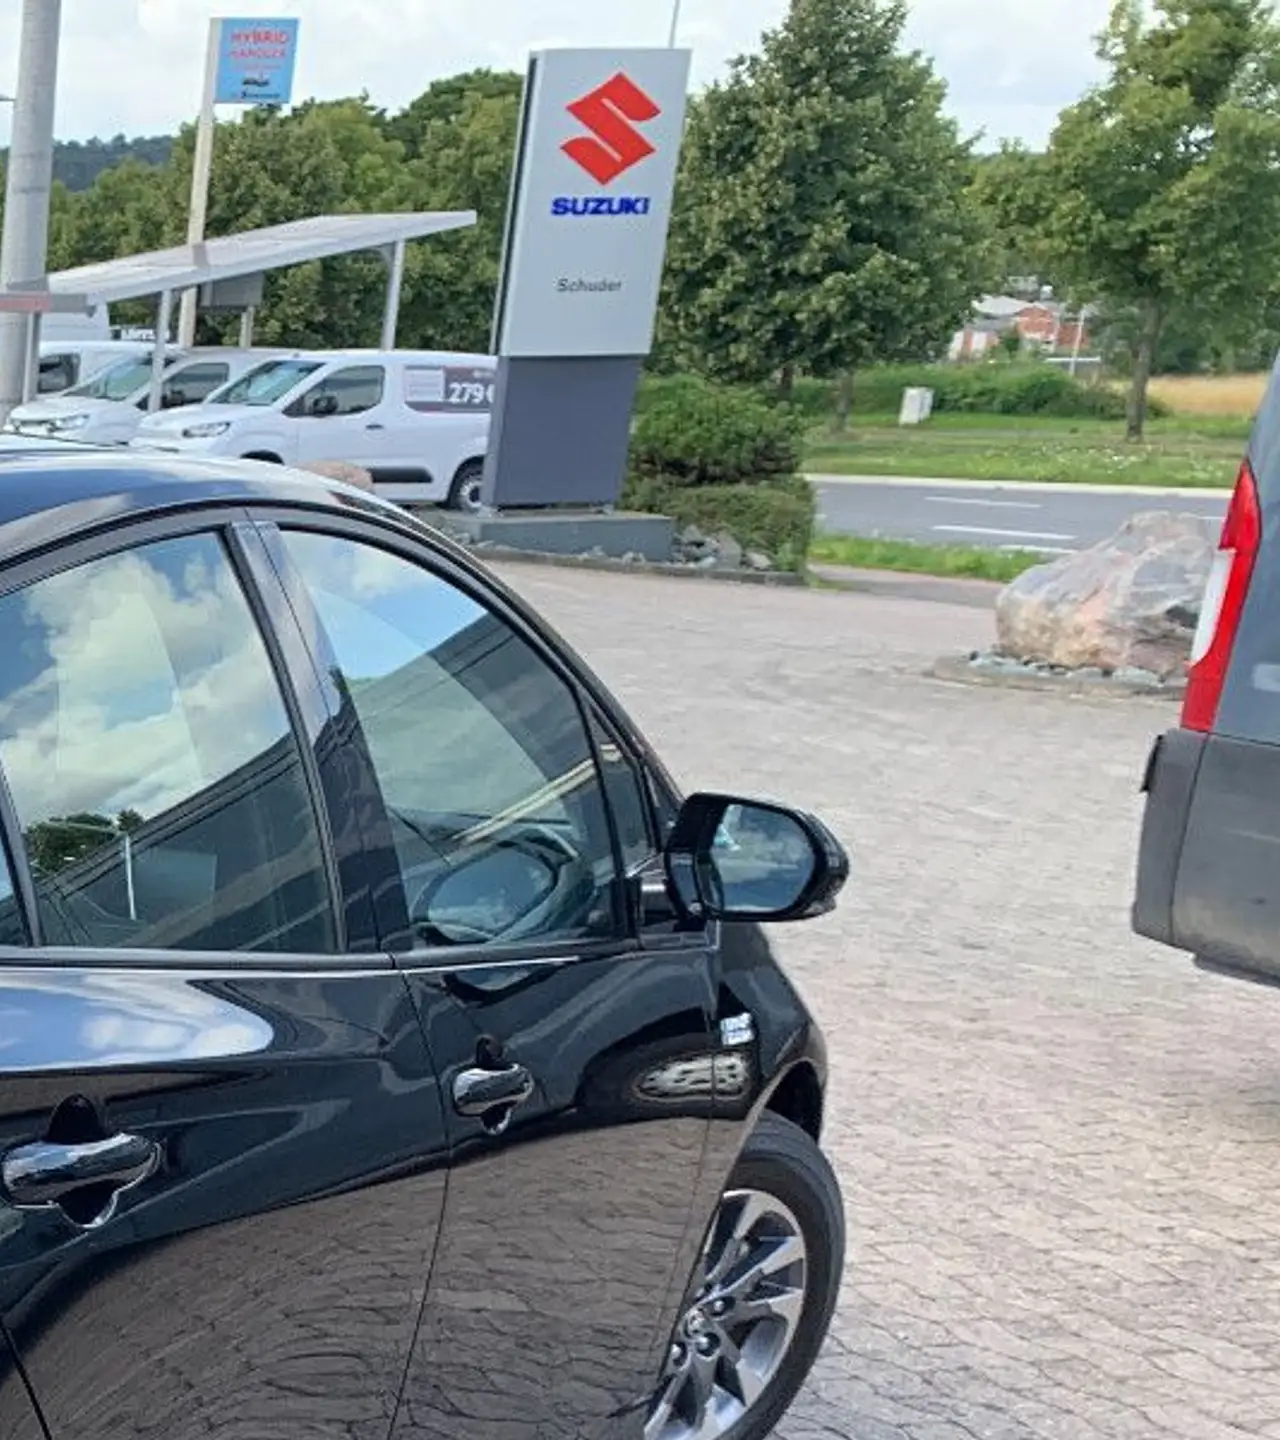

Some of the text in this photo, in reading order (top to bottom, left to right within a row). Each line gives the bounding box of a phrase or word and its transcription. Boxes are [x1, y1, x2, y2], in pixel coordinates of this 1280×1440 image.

[551, 197, 650, 216] SUZUKI
[557, 278, 622, 292] Schuder
[449, 382, 485, 404] 279
